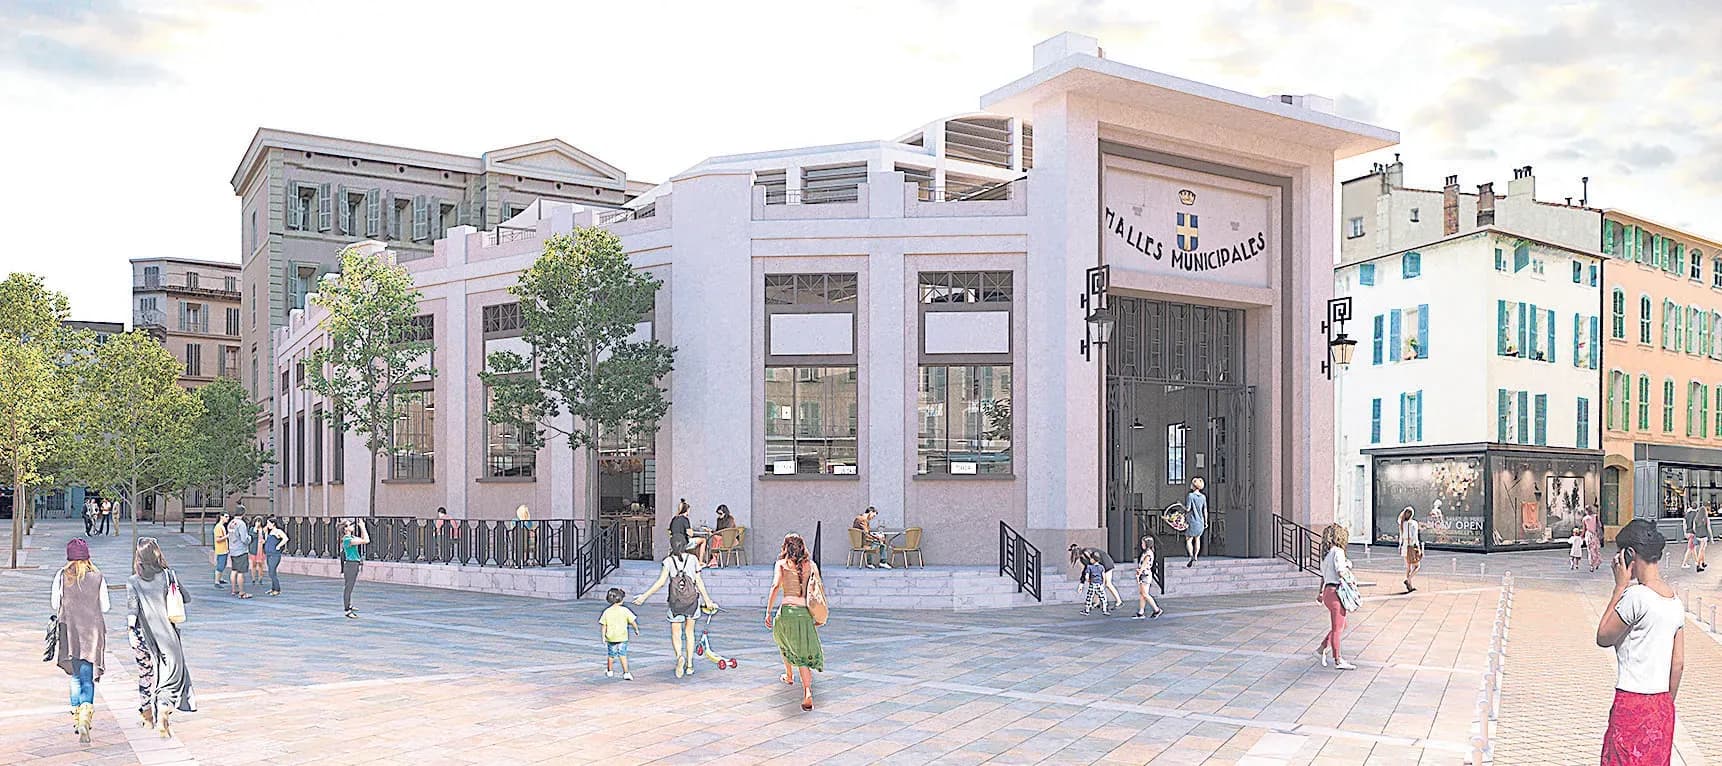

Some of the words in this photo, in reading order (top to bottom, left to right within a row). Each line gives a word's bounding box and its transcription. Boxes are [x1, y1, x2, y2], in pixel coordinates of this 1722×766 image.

[1105, 206, 1163, 261] HALLES
[1171, 231, 1265, 272] MUNICIPALES
[1428, 520, 1452, 530] NOW
[1455, 521, 1484, 530] OPEN
